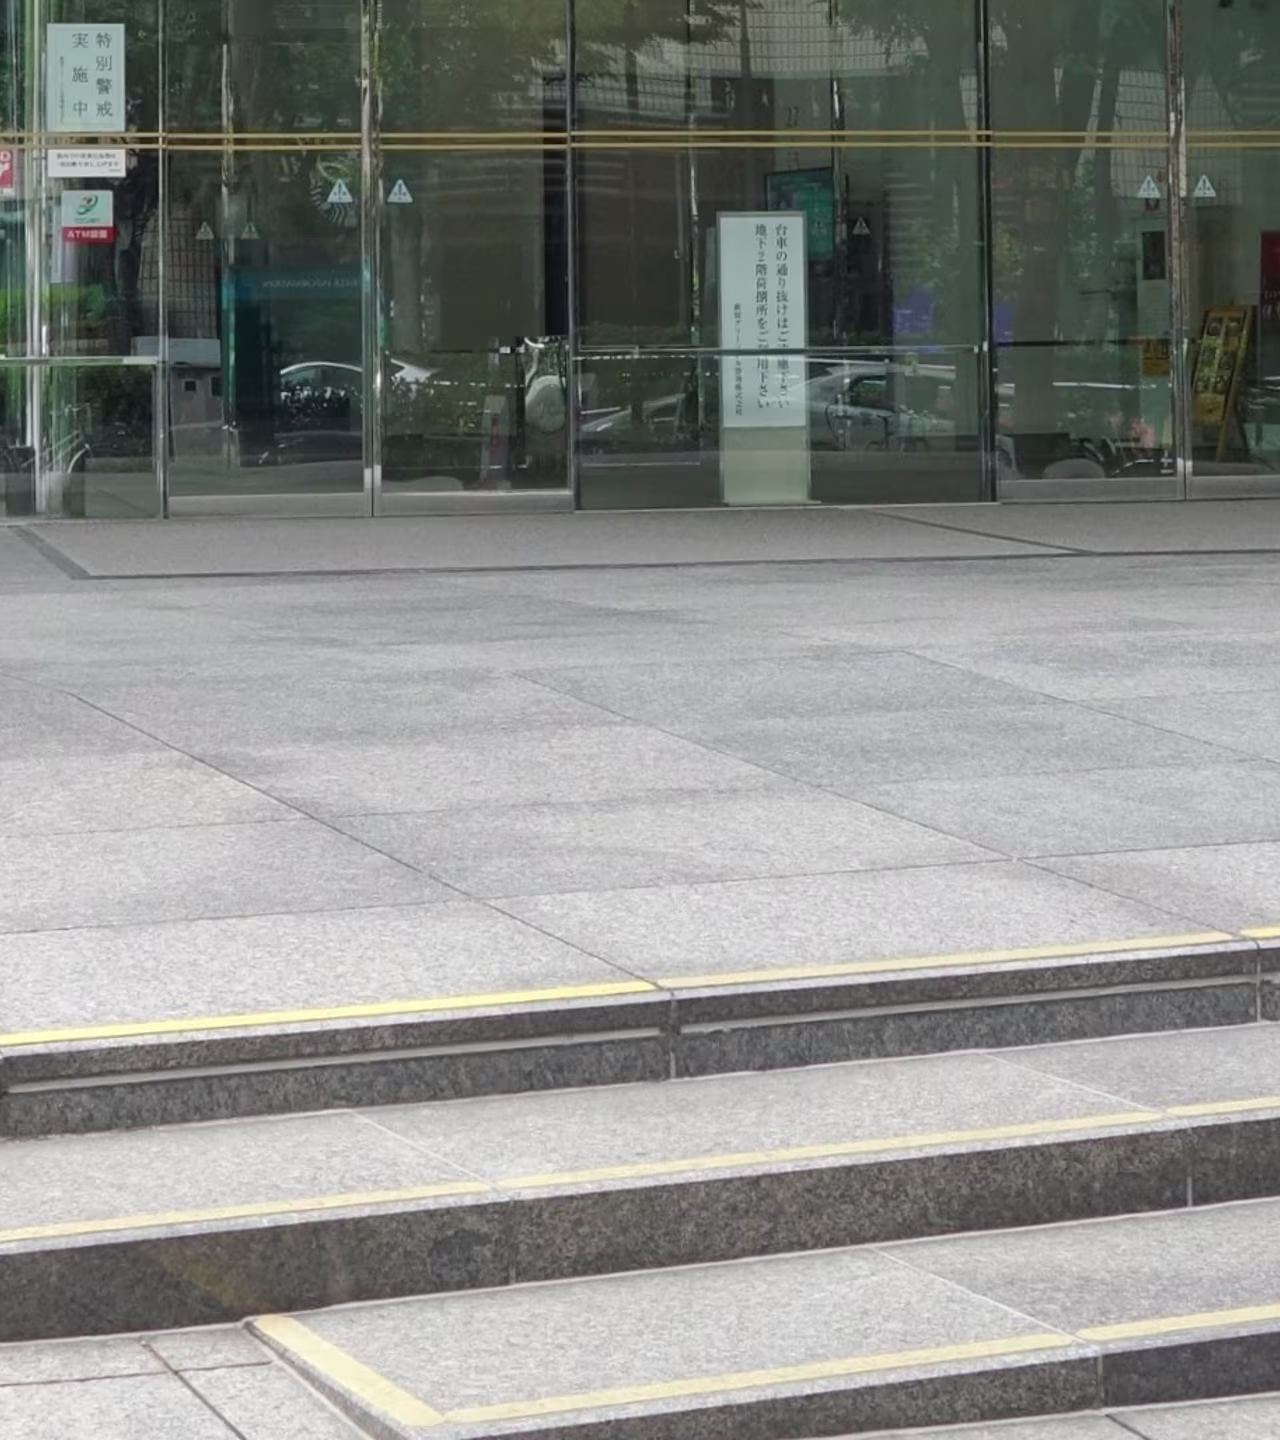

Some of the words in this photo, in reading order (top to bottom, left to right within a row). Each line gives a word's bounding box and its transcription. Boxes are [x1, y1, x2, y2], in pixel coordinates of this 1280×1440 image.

[72, 32, 89, 118] 実施中
[95, 32, 113, 117] 特別警戒
